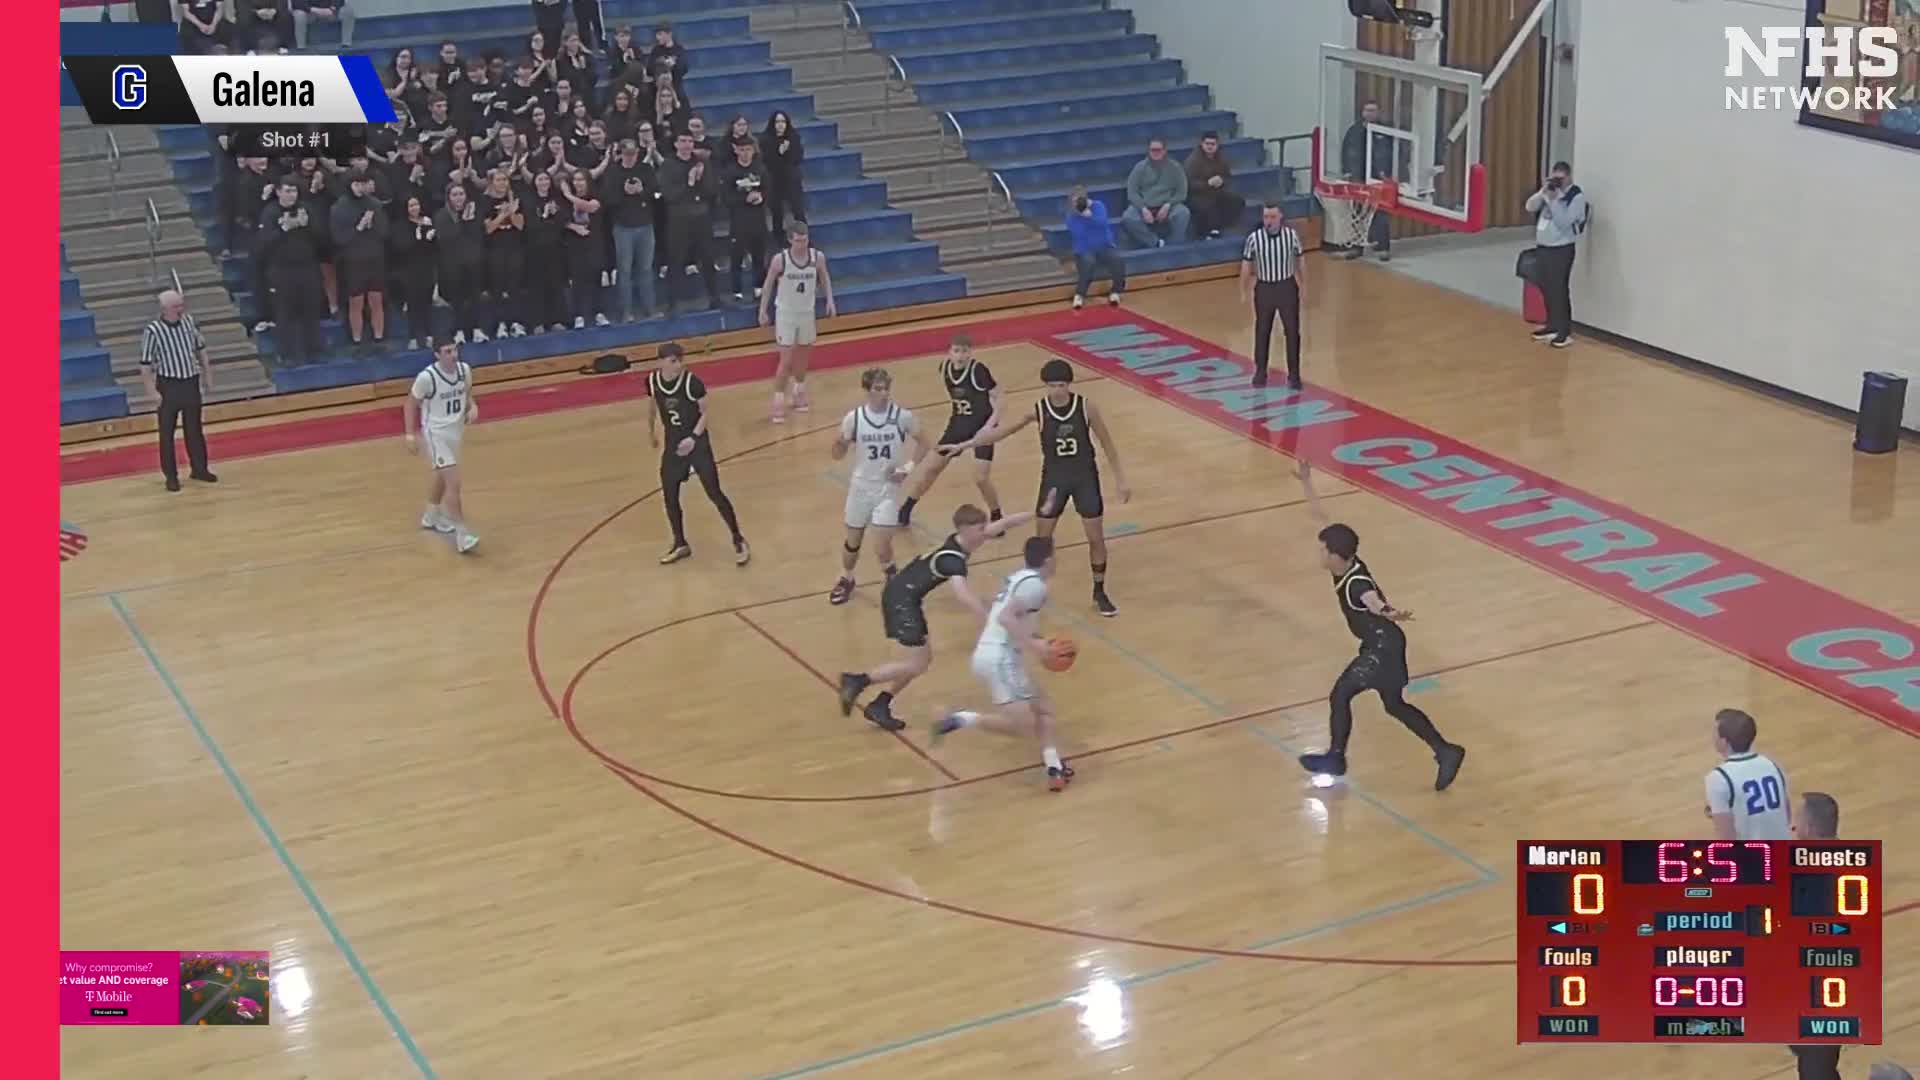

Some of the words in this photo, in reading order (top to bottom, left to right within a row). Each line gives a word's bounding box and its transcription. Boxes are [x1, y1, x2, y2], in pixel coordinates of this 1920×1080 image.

[795, 281, 806, 294] 4
[446, 398, 462, 416] 10
[667, 410, 682, 426] 2
[867, 444, 892, 461] 34
[1055, 437, 1078, 457] 23
[1052, 323, 1359, 432] MARIAN
[1331, 438, 1768, 617] CENTRAL
[1742, 775, 1781, 817] 20
